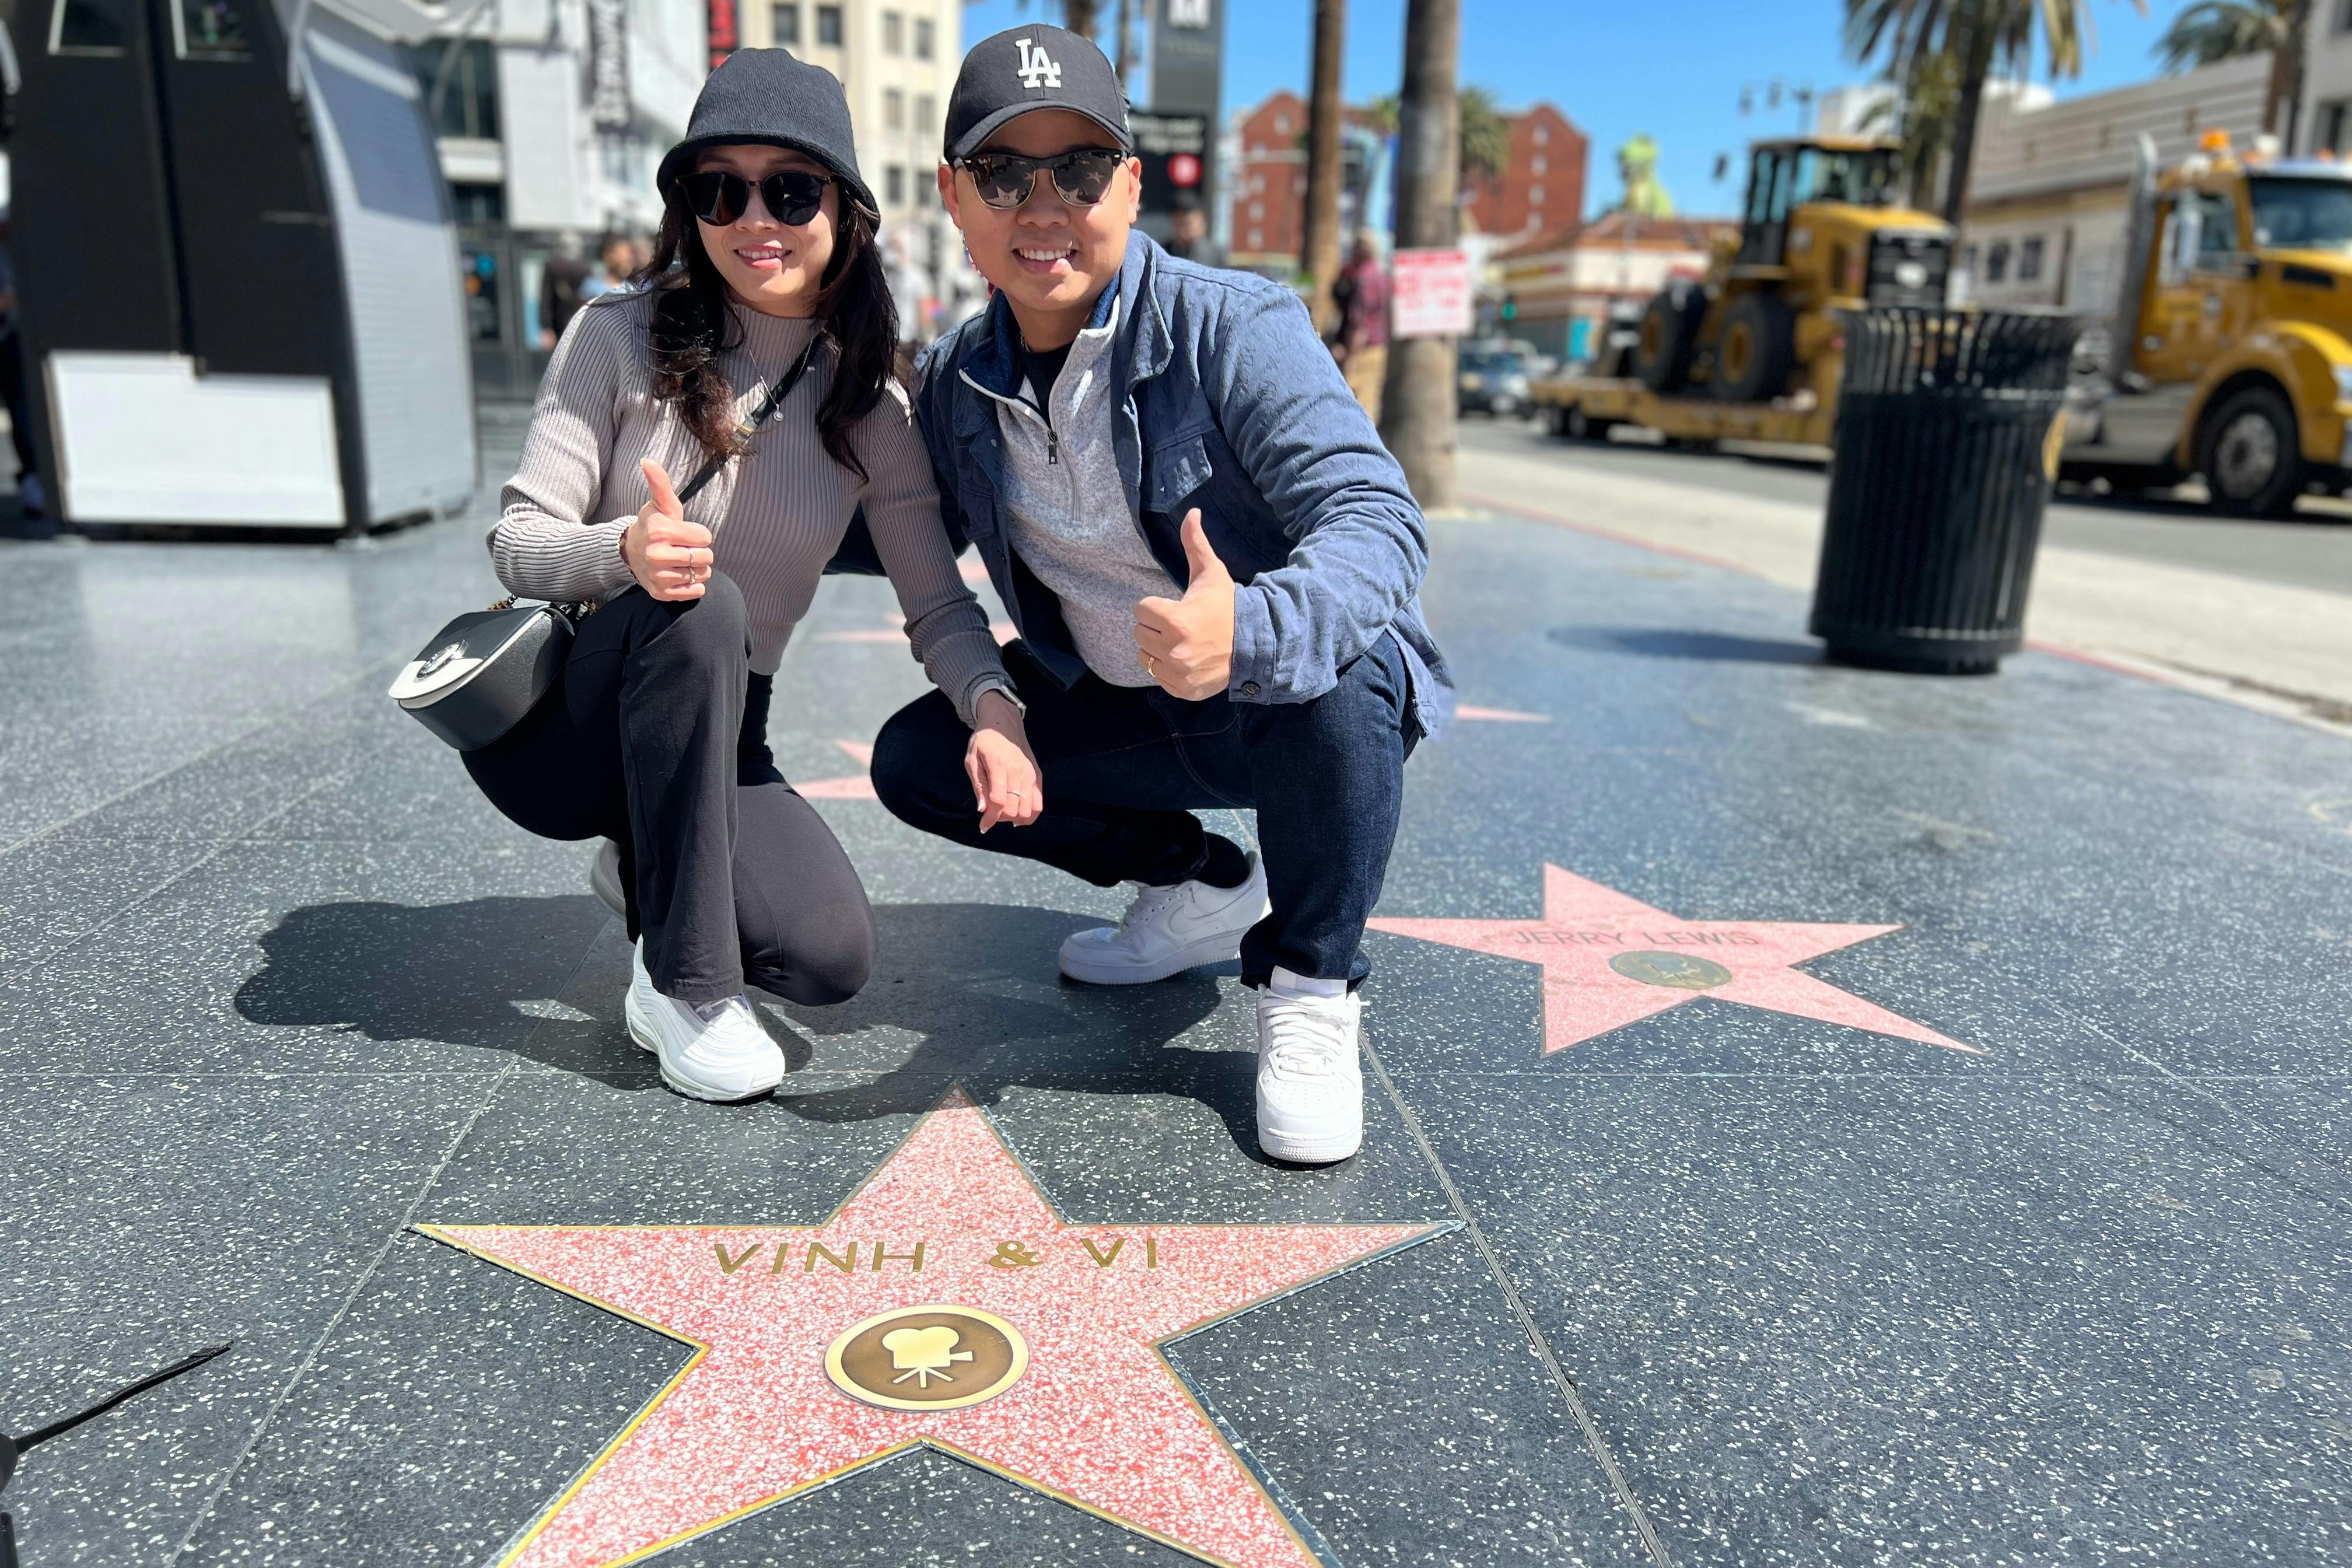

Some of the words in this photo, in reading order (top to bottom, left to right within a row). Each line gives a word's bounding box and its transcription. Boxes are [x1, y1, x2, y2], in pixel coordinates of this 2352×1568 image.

[1016, 38, 1061, 89] LA
[1514, 931, 1625, 945] JERRY
[1642, 932, 1760, 946] LEWIS
[714, 1241, 925, 1274] VINH
[989, 1241, 1044, 1268] &
[1080, 1238, 1156, 1269] VI
